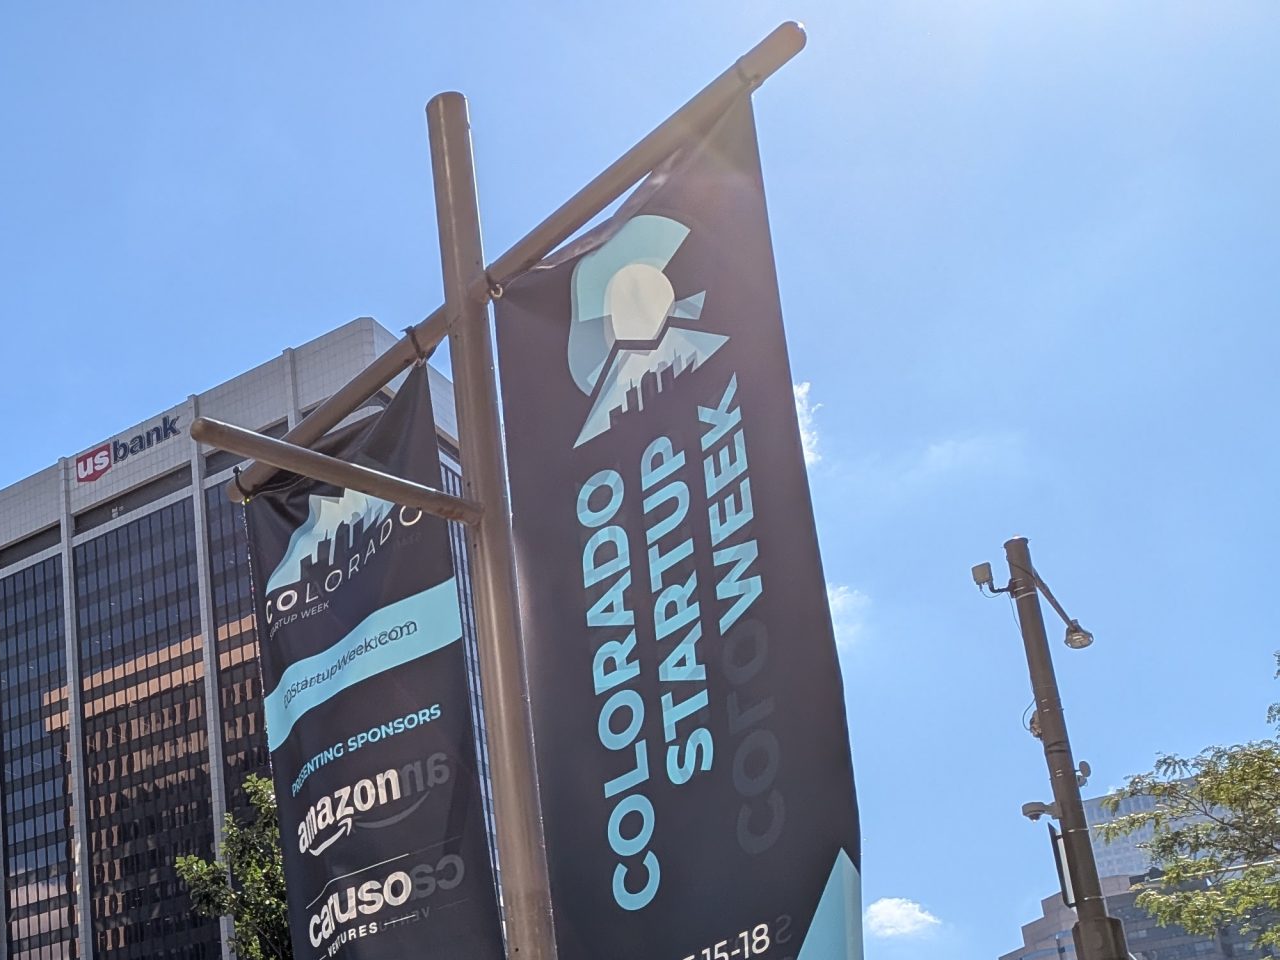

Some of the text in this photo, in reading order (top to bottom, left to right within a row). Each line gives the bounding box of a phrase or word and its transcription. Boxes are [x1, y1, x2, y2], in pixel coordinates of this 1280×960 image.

[78, 415, 180, 479] us bank
[697, 372, 764, 636] WEEK
[301, 599, 330, 619] WEEK
[640, 435, 714, 785] STARTUP
[576, 468, 661, 911] COLORADO
[291, 742, 344, 797] PRESENTING
[347, 703, 441, 752] SPONSORS
[298, 769, 401, 853] amazon
[310, 871, 412, 947] caruso
[327, 922, 378, 957] VENTURES
